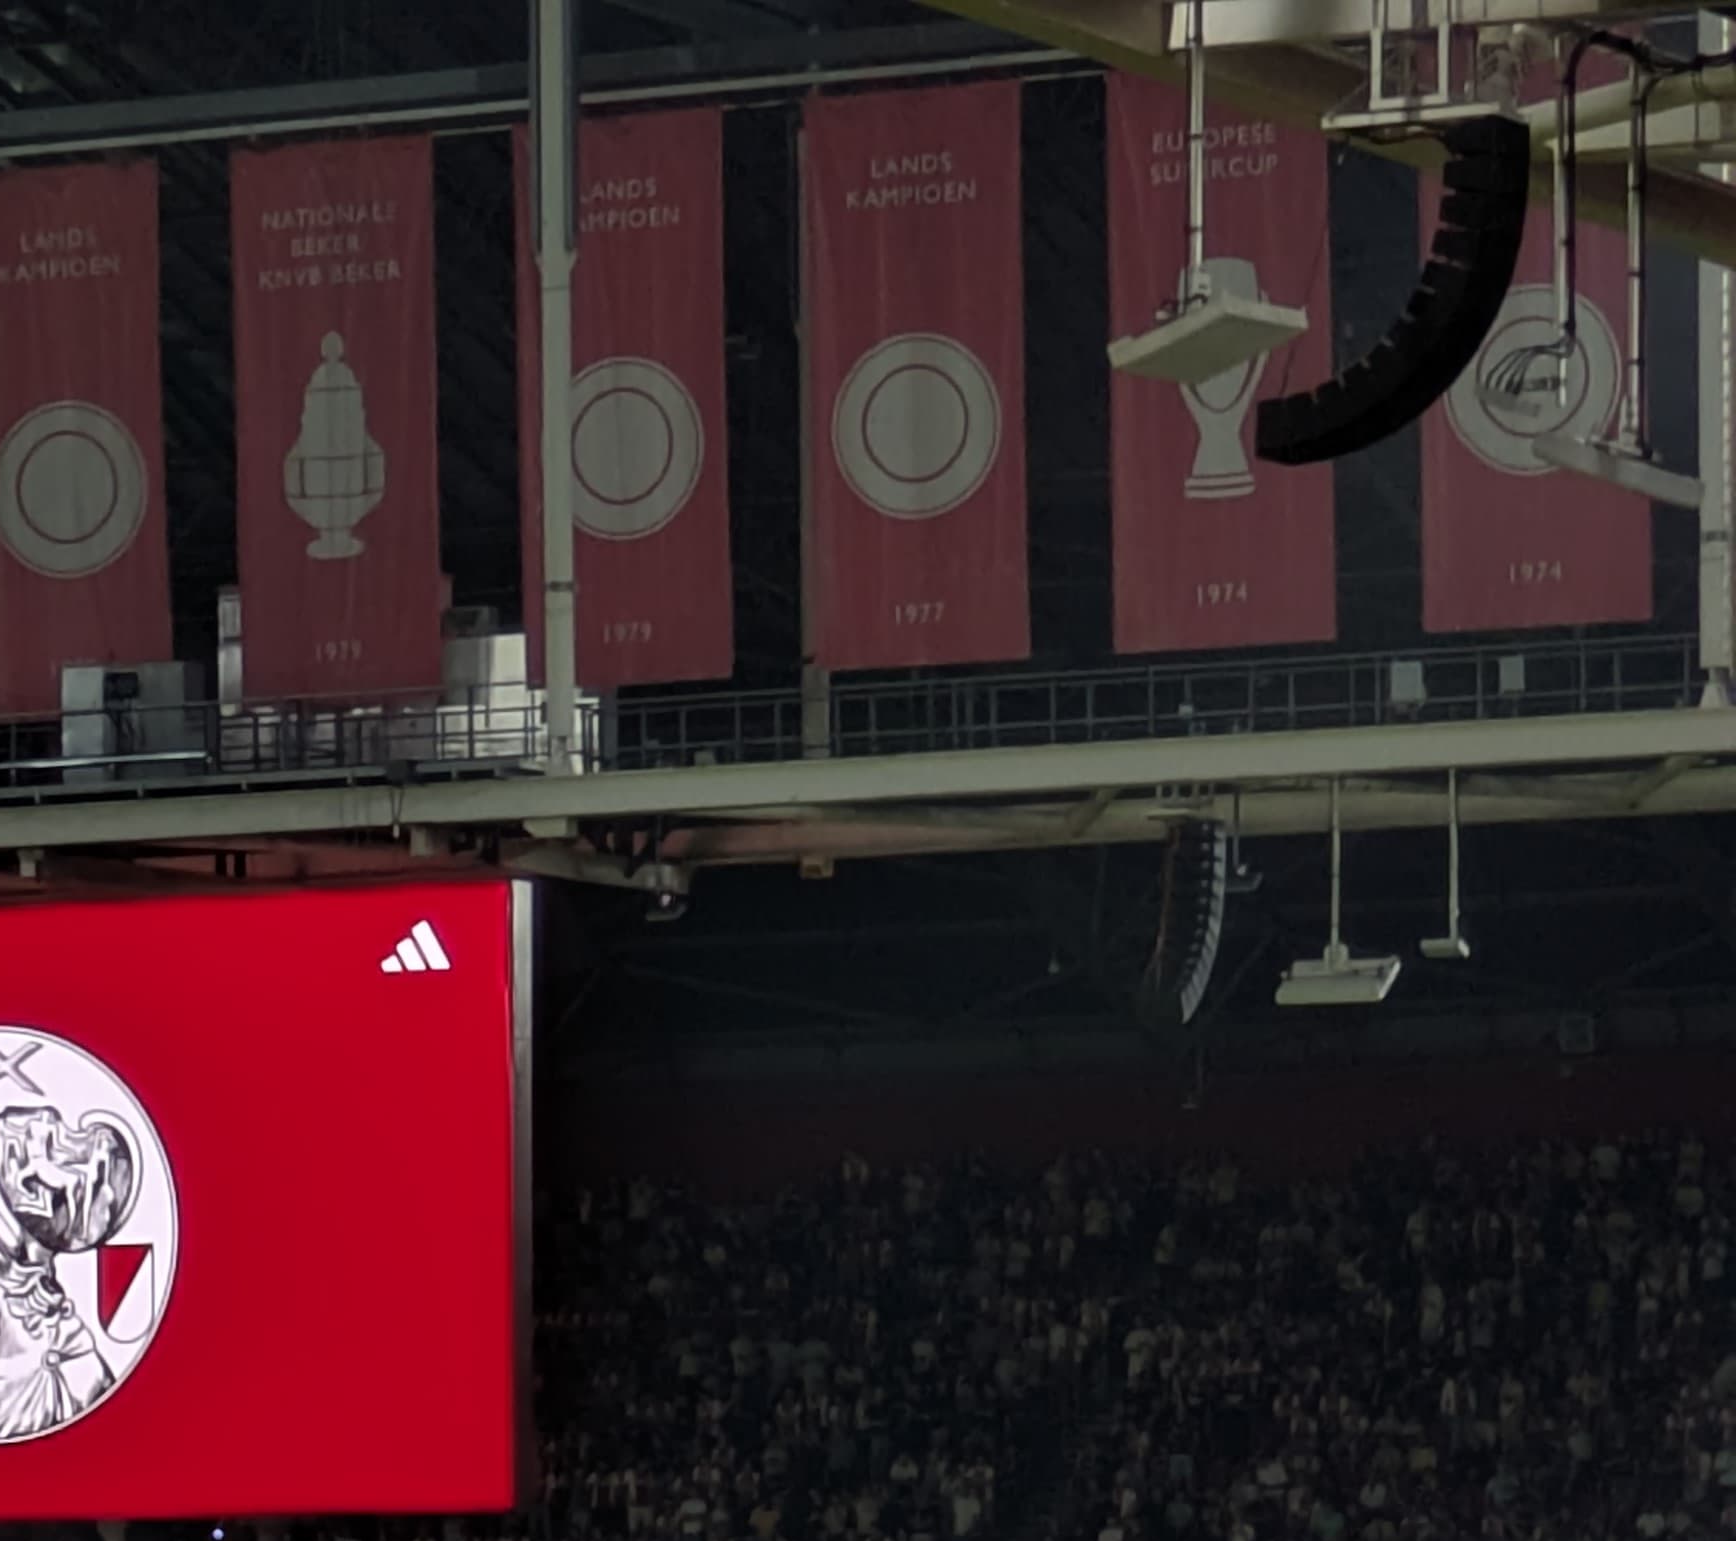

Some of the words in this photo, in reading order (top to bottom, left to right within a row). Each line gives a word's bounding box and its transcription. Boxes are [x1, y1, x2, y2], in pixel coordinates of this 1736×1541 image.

[1150, 122, 1277, 154] EUOPESE
[870, 152, 953, 180] LANDS
[1150, 153, 1279, 186] SURCUP
[845, 180, 978, 210] KAMPIOEN
[1509, 560, 1563, 584] 1974
[1197, 582, 1249, 606] 1974
[895, 602, 946, 625] 1977
[602, 621, 653, 645] 1979
